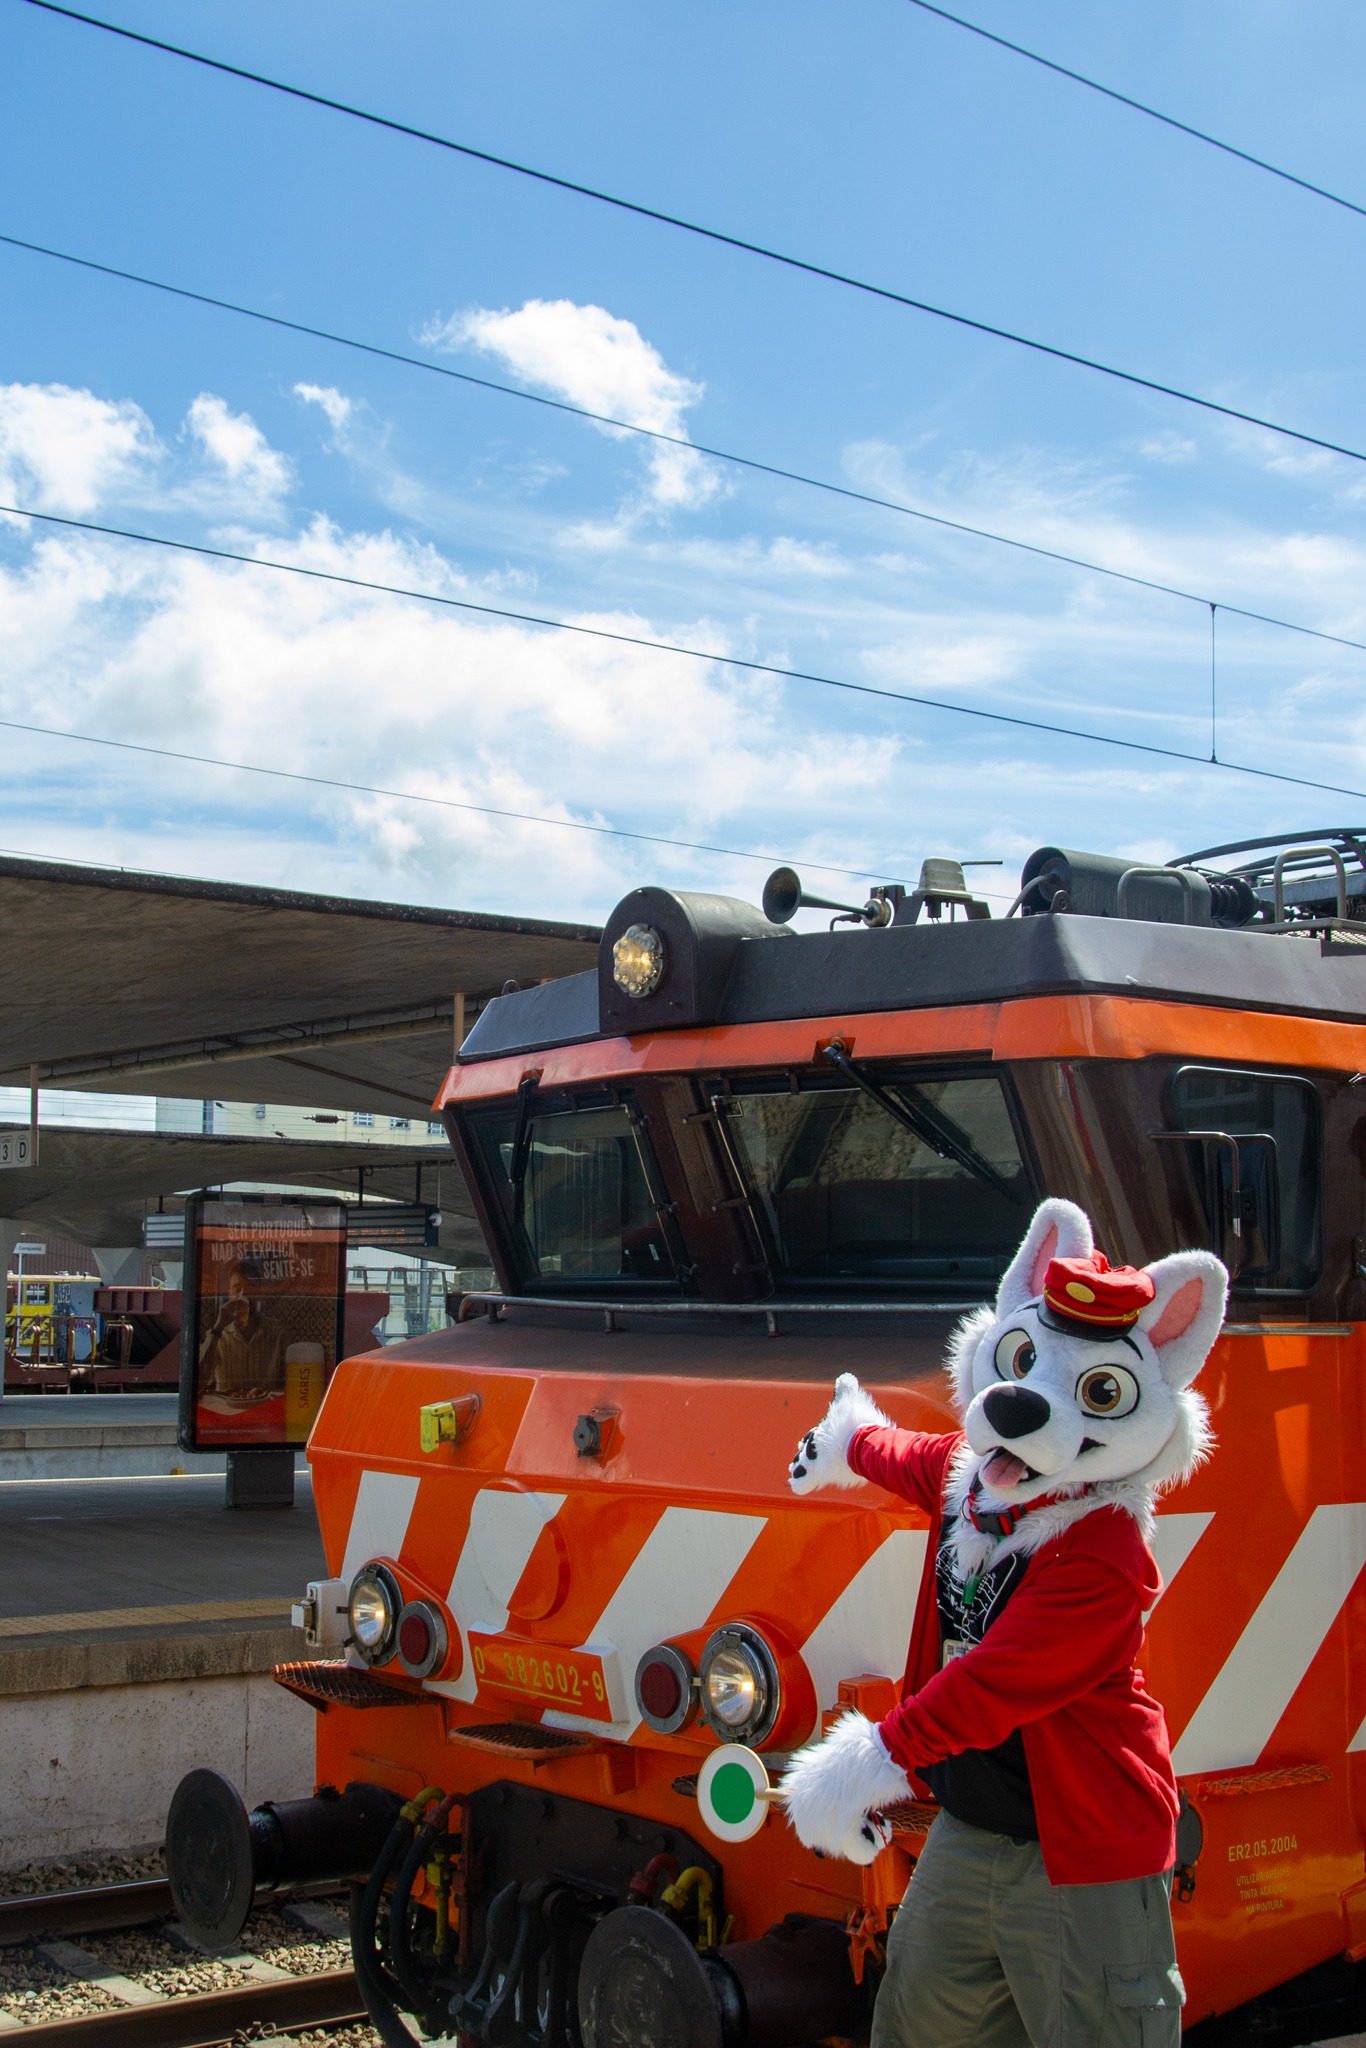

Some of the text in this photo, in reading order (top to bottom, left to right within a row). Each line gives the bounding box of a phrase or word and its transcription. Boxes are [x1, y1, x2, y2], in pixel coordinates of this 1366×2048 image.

[3, 1142, 26, 1160] 3 D
[228, 1221, 248, 1240] SER
[211, 1239, 298, 1261] NÃO SE EXPLICA,
[263, 1259, 314, 1279] SENTE-SE
[299, 1368, 310, 1409] SAGRES
[503, 1652, 604, 1701] 382602-9
[1228, 1835, 1297, 1862] ER2.05.2004
[1236, 1866, 1290, 1887] UTILIZAR APENAS
[1240, 1889, 1258, 1900] TINTA
[1245, 1899, 1284, 1915] NA PINTURA
